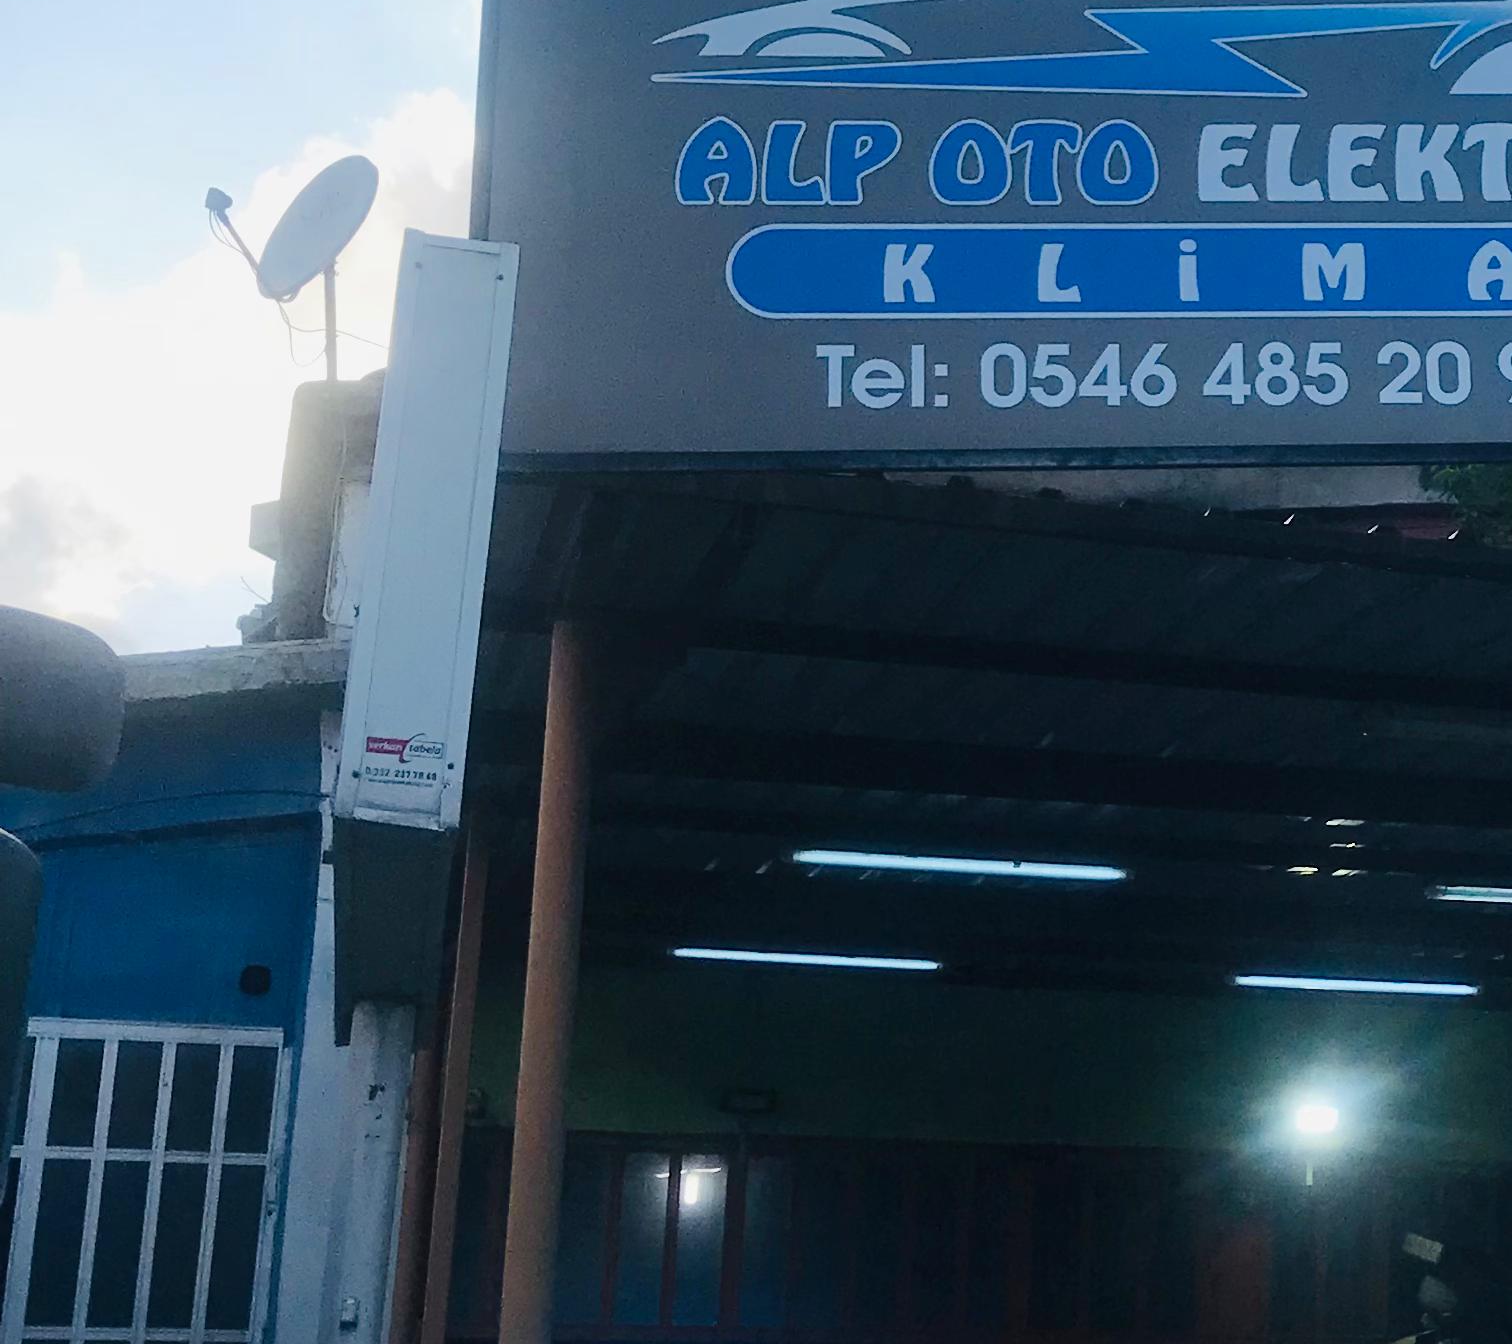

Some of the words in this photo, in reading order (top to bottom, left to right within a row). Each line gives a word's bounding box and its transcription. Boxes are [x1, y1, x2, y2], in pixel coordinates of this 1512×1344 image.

[675, 116, 902, 207] ALP
[928, 118, 1160, 207] OTO
[816, 343, 949, 410] Tel:
[979, 341, 1177, 408] 0546
[1203, 340, 1349, 407] 485
[1378, 339, 1472, 406] 20
